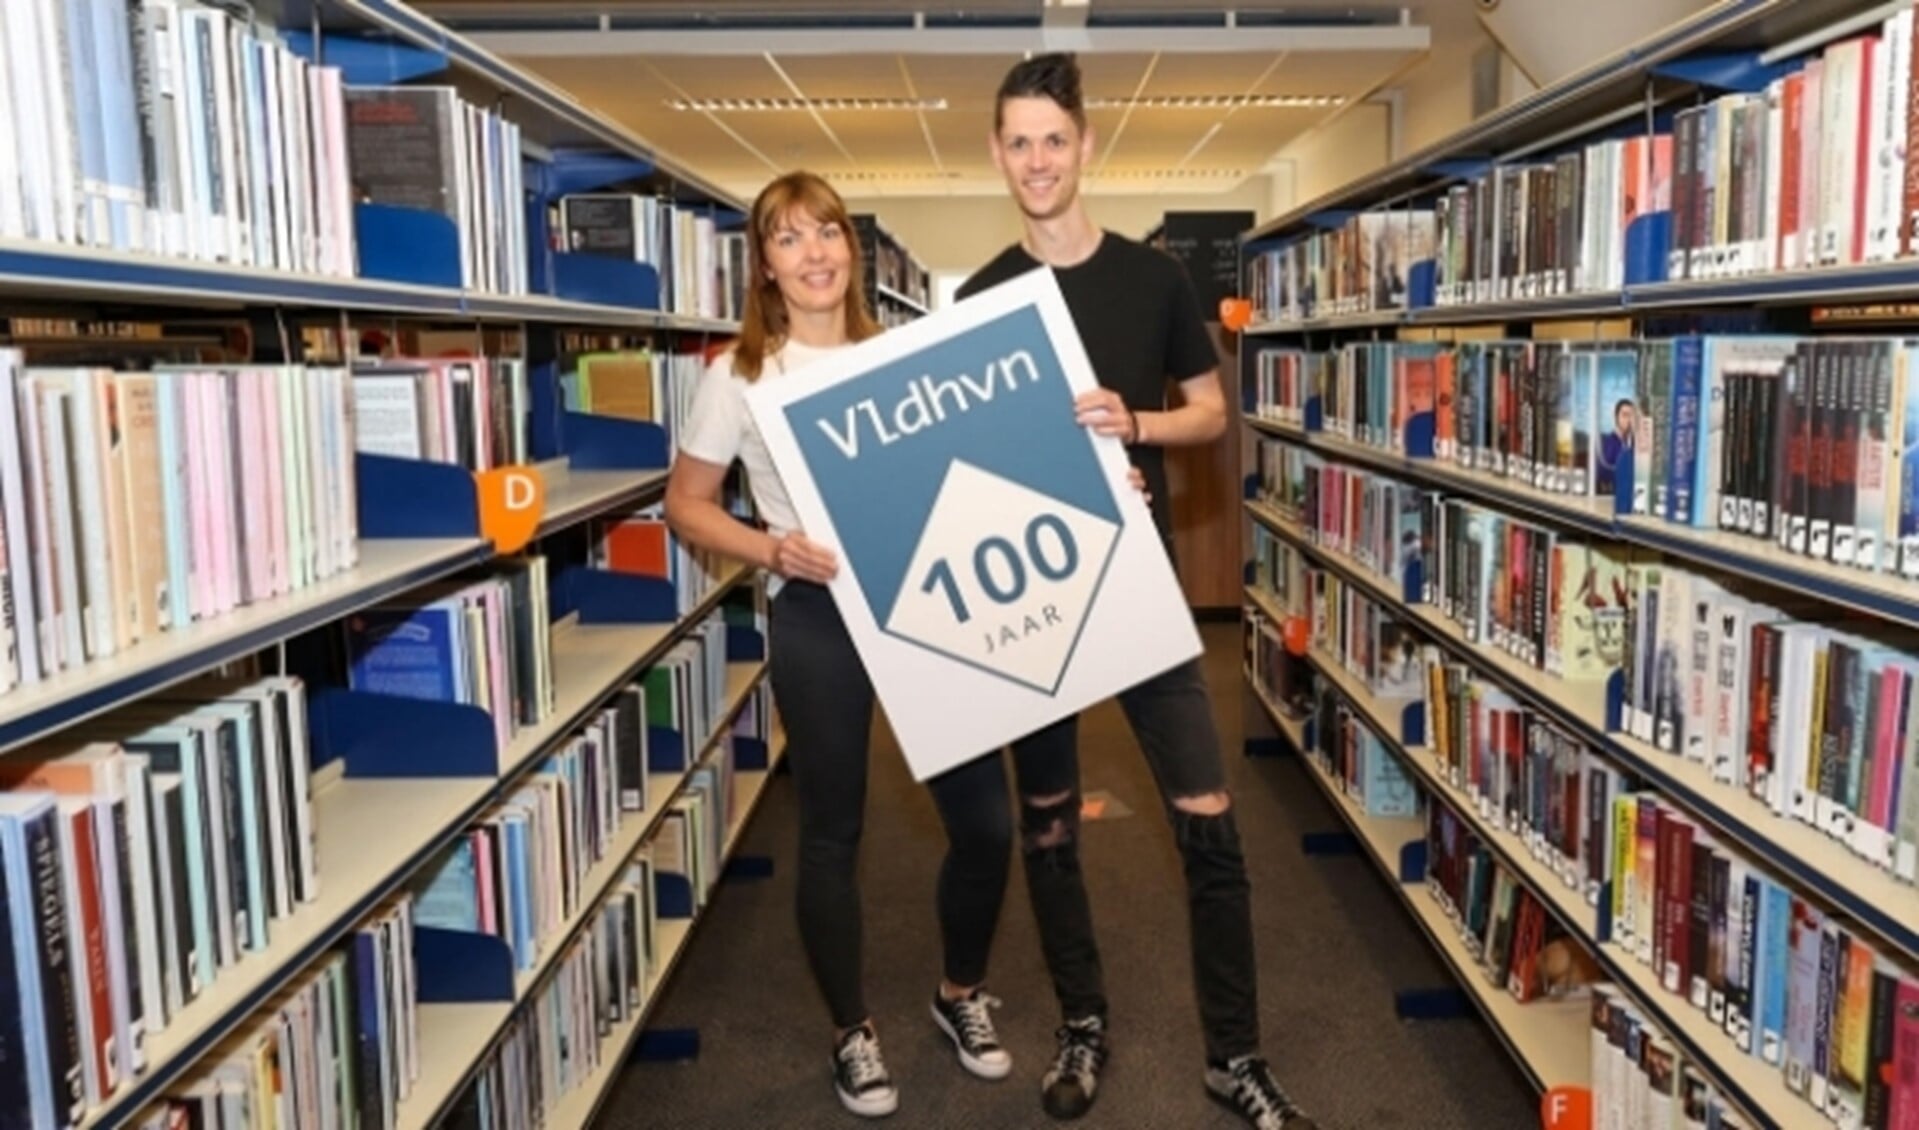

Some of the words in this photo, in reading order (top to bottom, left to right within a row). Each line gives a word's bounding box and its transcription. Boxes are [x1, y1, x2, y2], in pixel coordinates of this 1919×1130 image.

[505, 474, 535, 510] D
[920, 513, 1079, 625] 100
[983, 604, 1063, 653] JAAR
[1552, 1094, 1568, 1124] F
